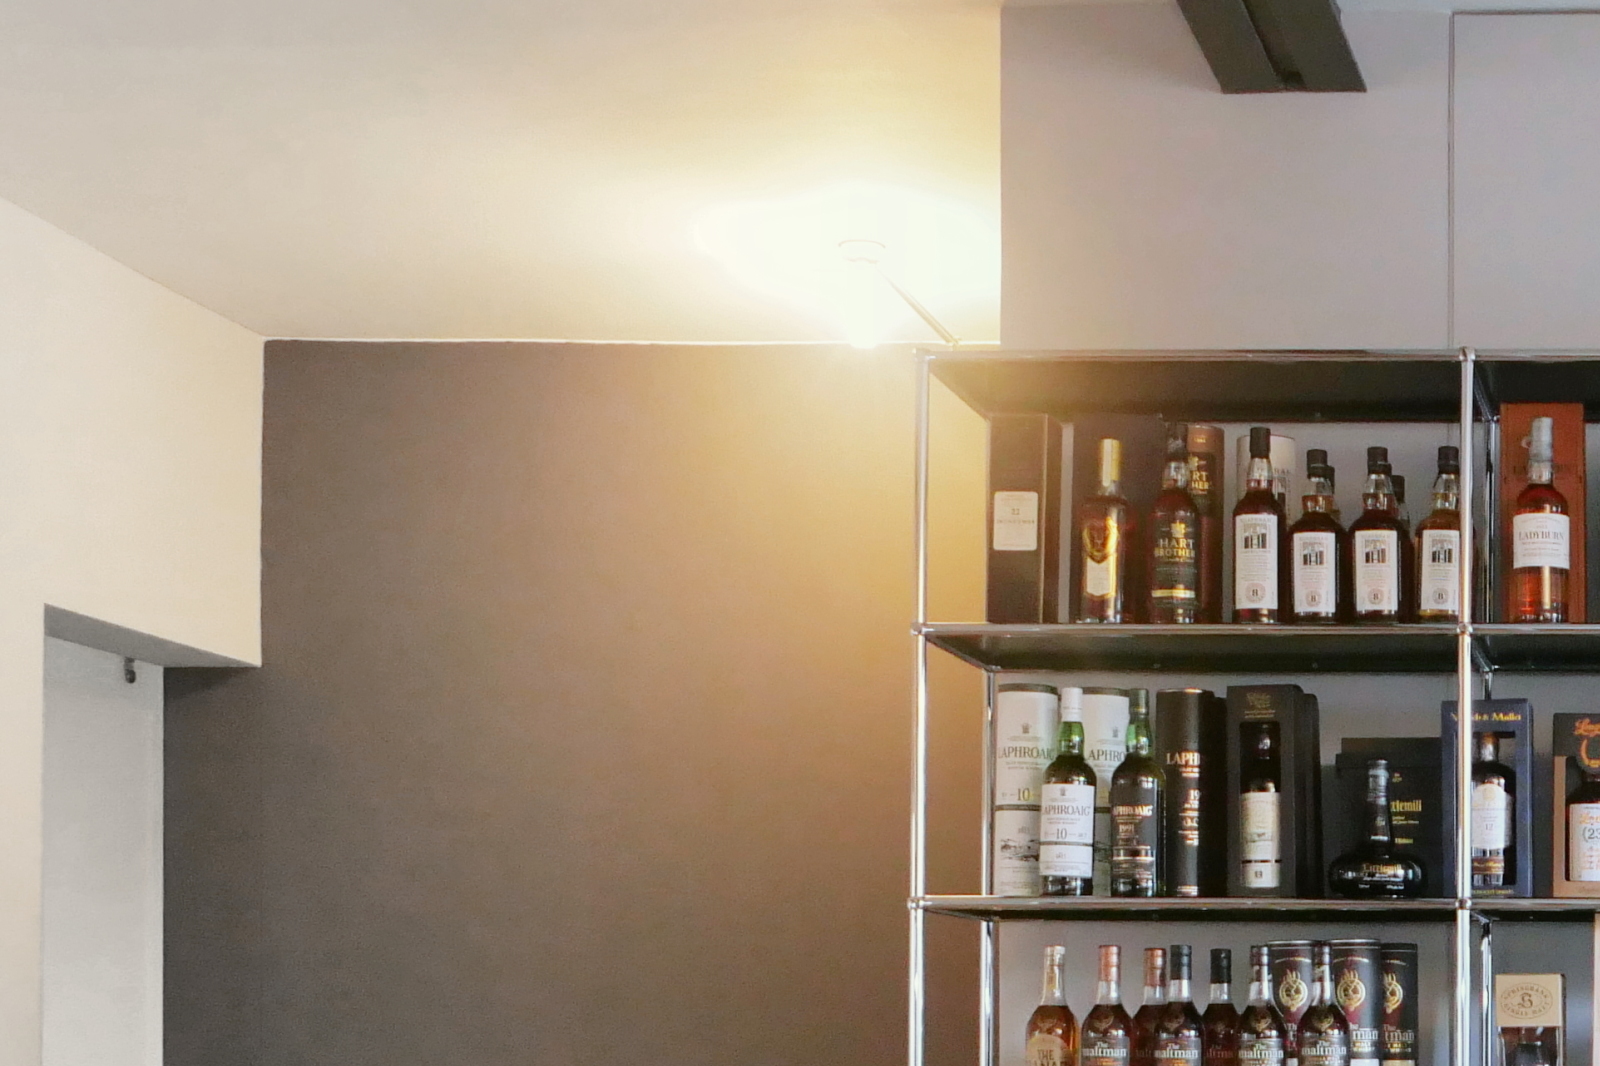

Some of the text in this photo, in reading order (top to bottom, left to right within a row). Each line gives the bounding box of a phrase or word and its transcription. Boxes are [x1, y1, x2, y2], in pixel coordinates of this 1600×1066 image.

[1518, 531, 1565, 541] LADYBURN
[1159, 538, 1195, 549] HART
[998, 746, 1056, 761] LAPHROAIG
[1088, 749, 1125, 762] APHRO
[1017, 788, 1031, 801] 10
[1041, 804, 1090, 816] APHROAIG
[1056, 828, 1067, 840] 10
[1503, 984, 1550, 999] SPRINGBANK
[1037, 1049, 1055, 1061] THE
[1239, 1047, 1284, 1059] maltman
[1301, 1044, 1347, 1056] maltman
